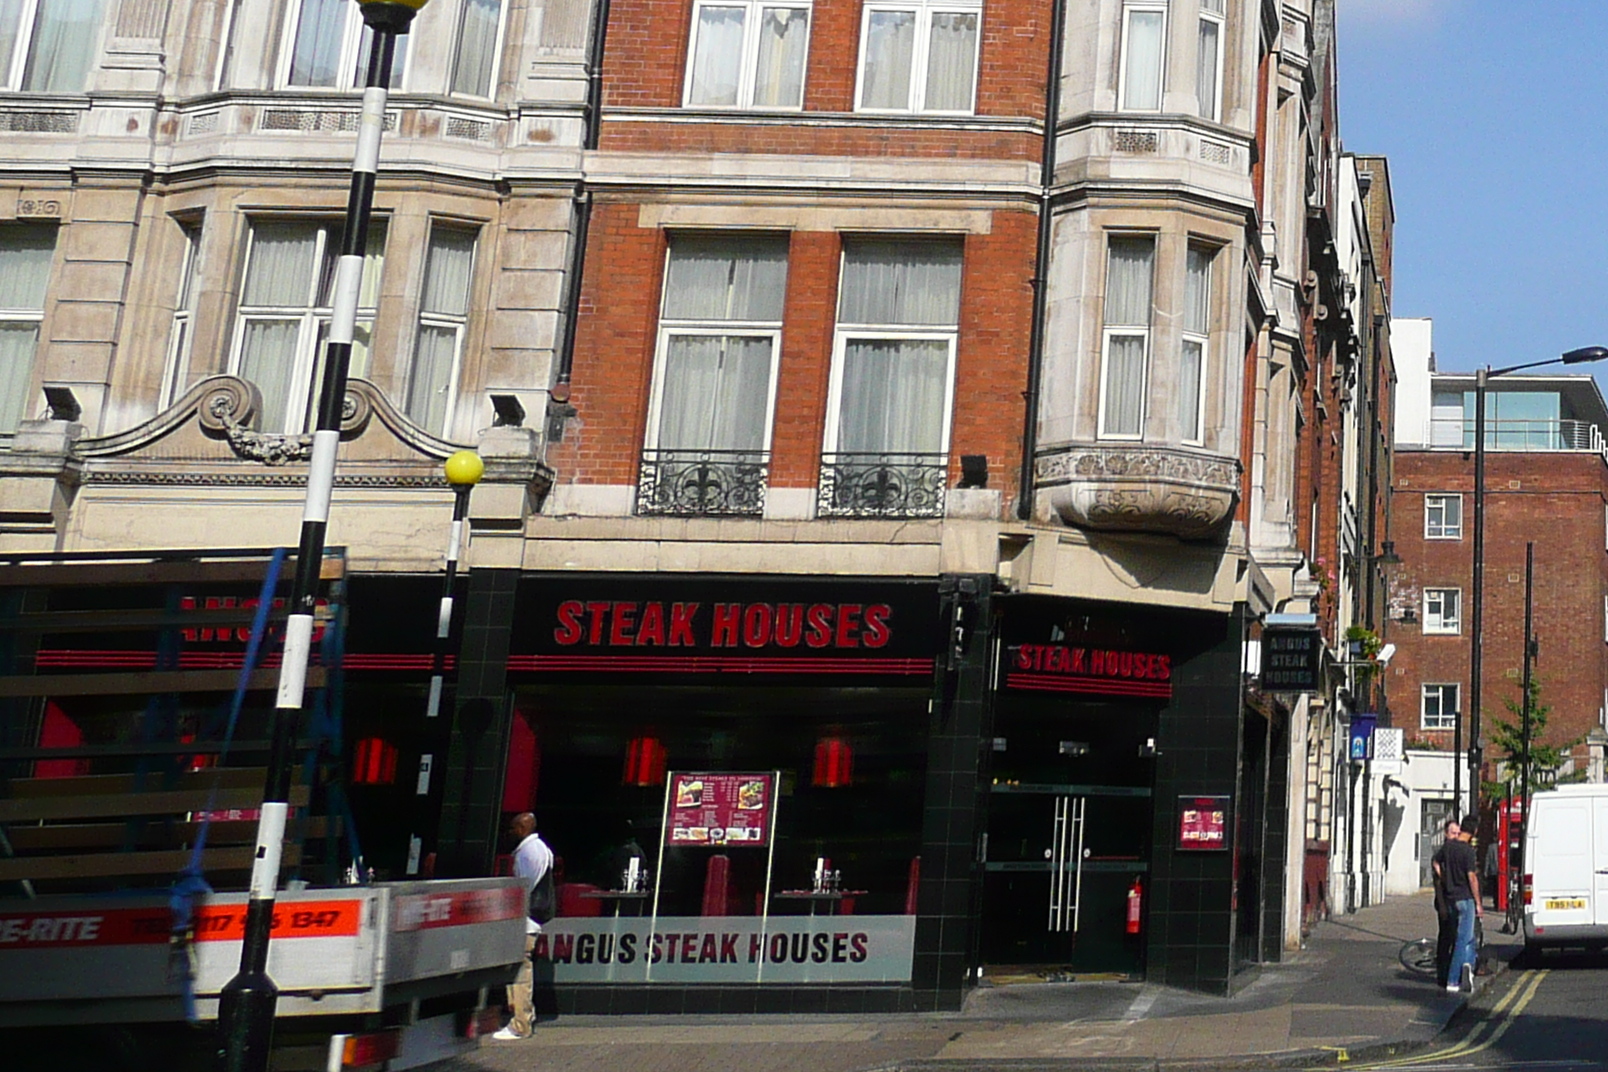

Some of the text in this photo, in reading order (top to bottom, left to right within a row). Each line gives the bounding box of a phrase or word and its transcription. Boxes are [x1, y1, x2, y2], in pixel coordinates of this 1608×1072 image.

[554, 599, 893, 649] STEAK HOUSES
[1018, 642, 1172, 679] STEAK HOUSES
[1271, 654, 1309, 667] STEAK
[1265, 671, 1313, 684] HOUSES
[291, 910, 341, 928] 1347
[535, 932, 869, 965] ANGUS STEAK HOUSES
